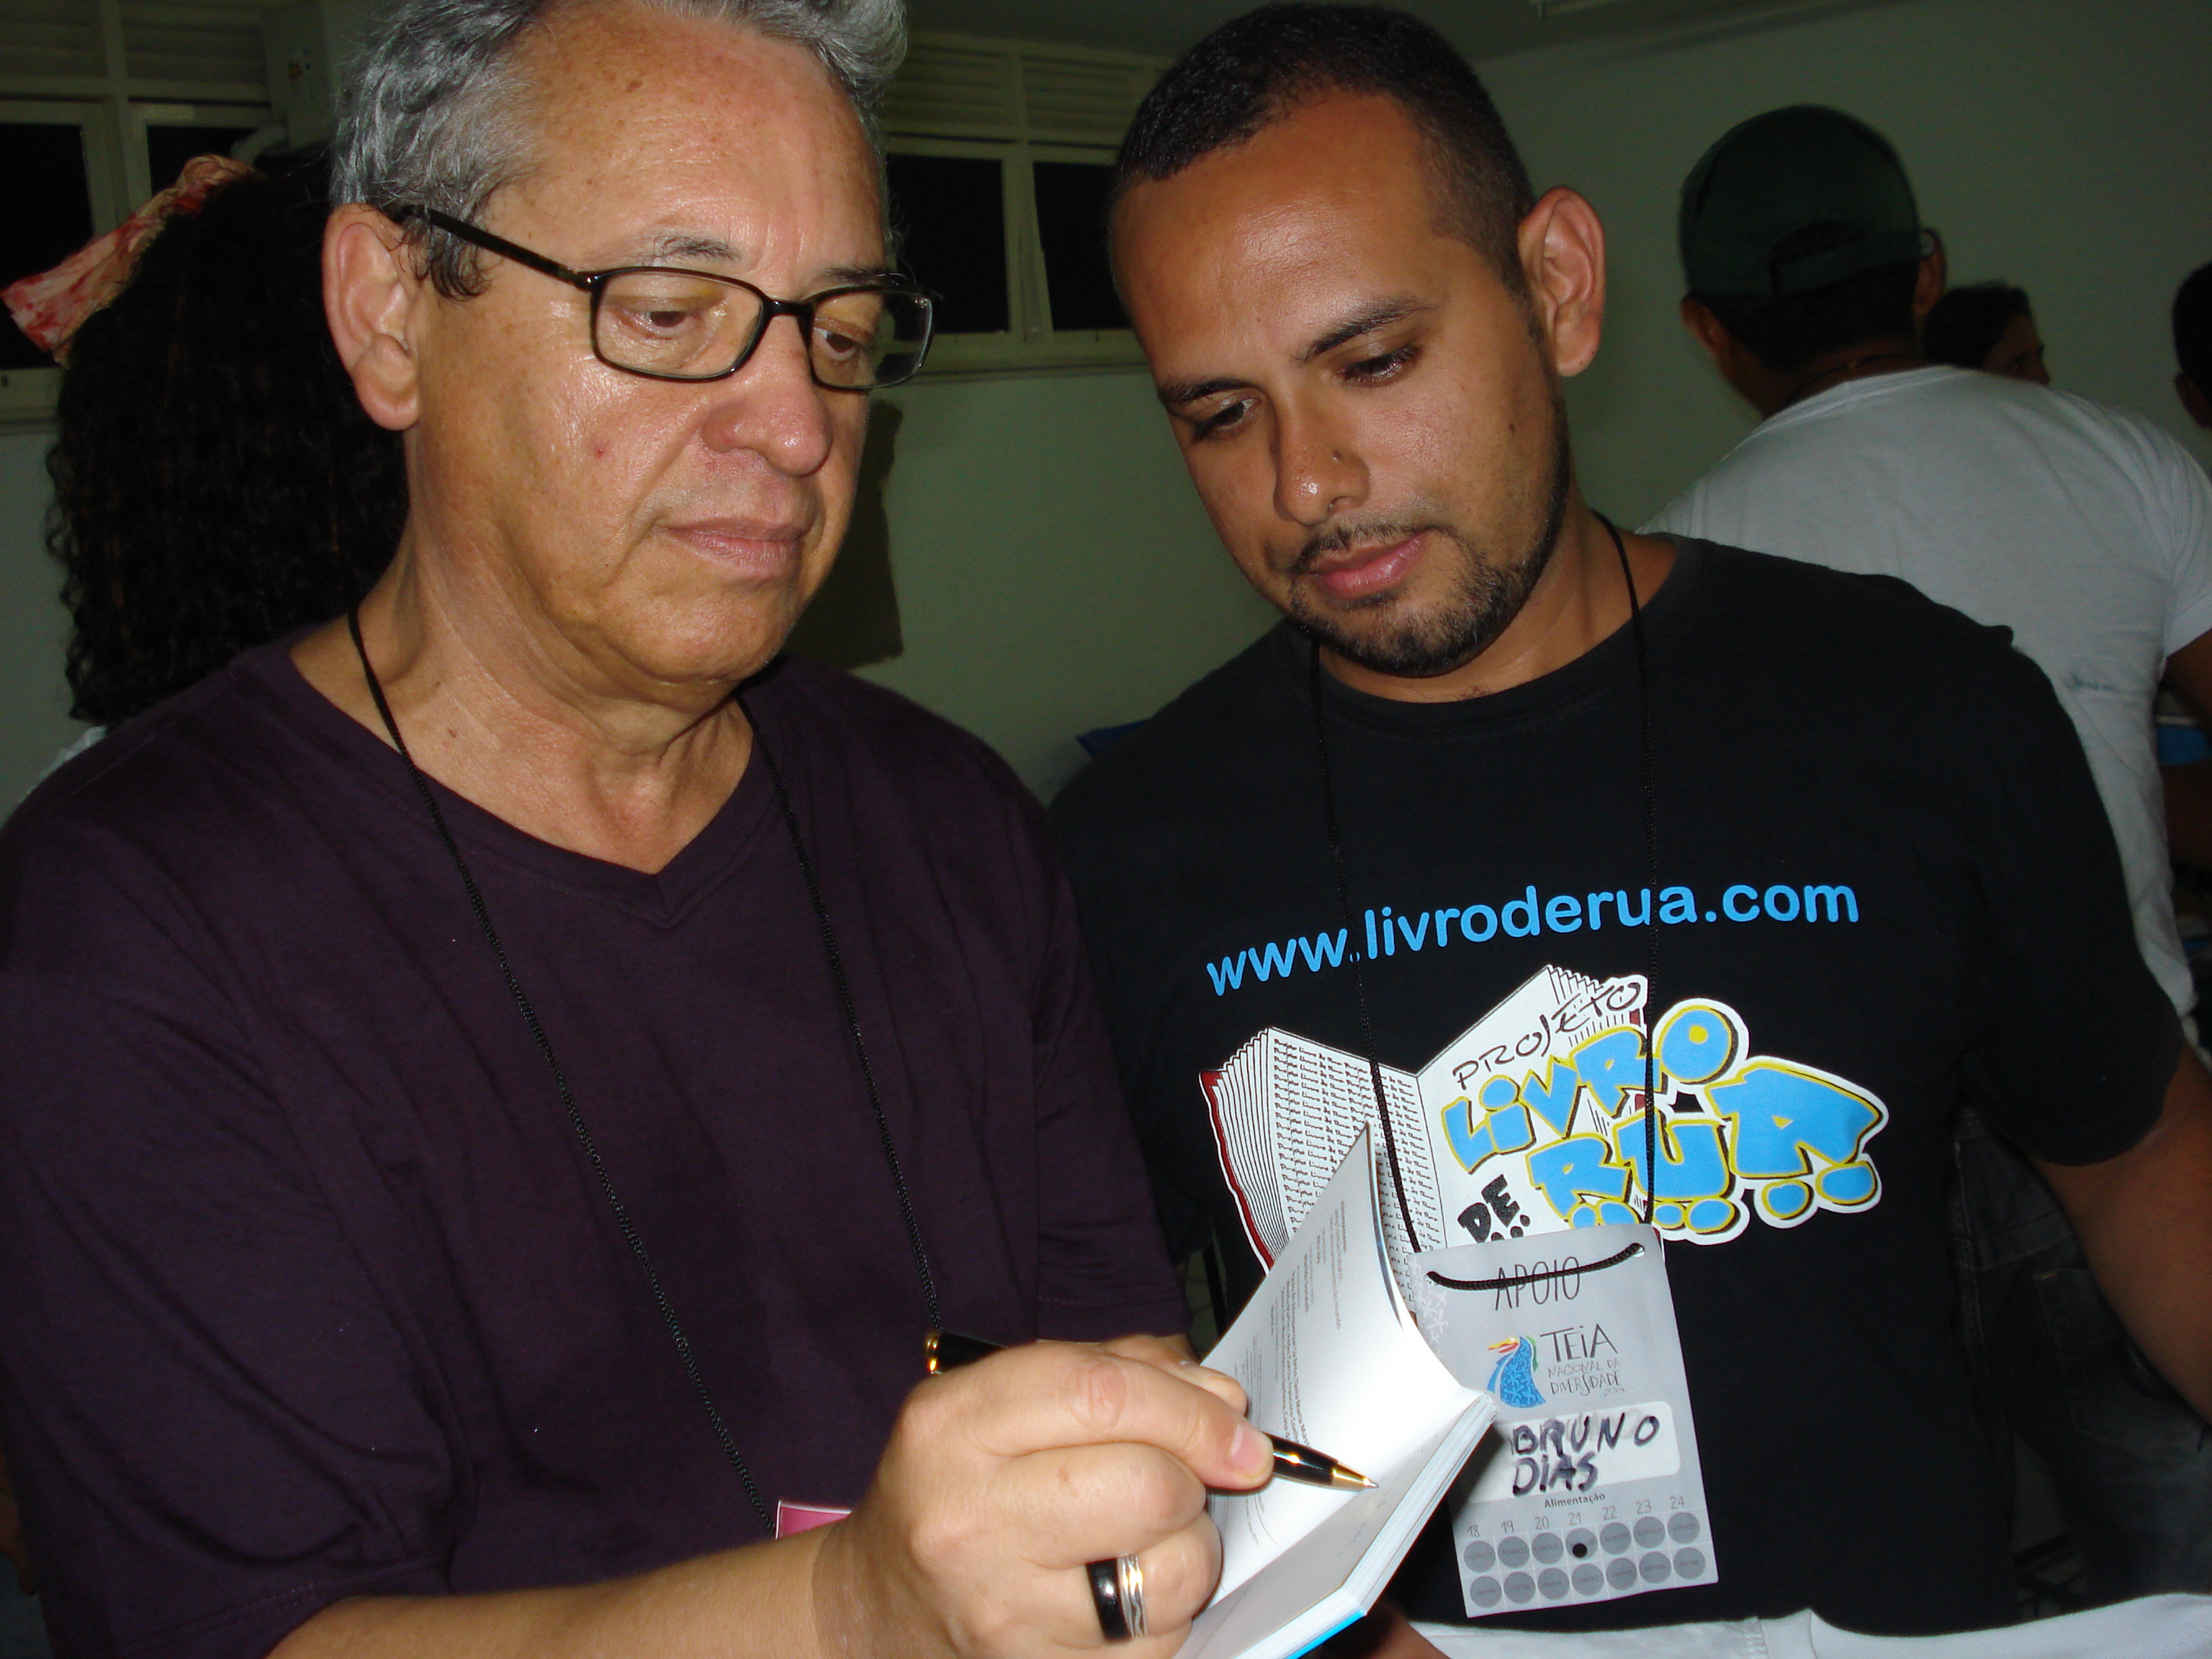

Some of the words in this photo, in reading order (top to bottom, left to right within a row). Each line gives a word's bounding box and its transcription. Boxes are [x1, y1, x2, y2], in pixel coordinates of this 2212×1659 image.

[1206, 884, 1860, 997] www.livroderua.com
[1452, 981, 1642, 1091] PROJETO
[1496, 1256, 1580, 1311] APOIO
[1548, 1360, 1604, 1378] NACIONAL
[1606, 1358, 1621, 1369] DA
[1604, 1387, 1625, 1396] 2014
[1511, 1411, 1660, 1457] BRUNO
[1467, 1524, 1480, 1538] 18
[1501, 1520, 1514, 1534] 19
[1534, 1516, 1550, 1530] 20
[1568, 1512, 1582, 1526] 21
[1601, 1506, 1618, 1521] 22
[1635, 1500, 1652, 1515] 23
[1669, 1496, 1685, 1510] 24
[1545, 1493, 1606, 1509] Alimentação
